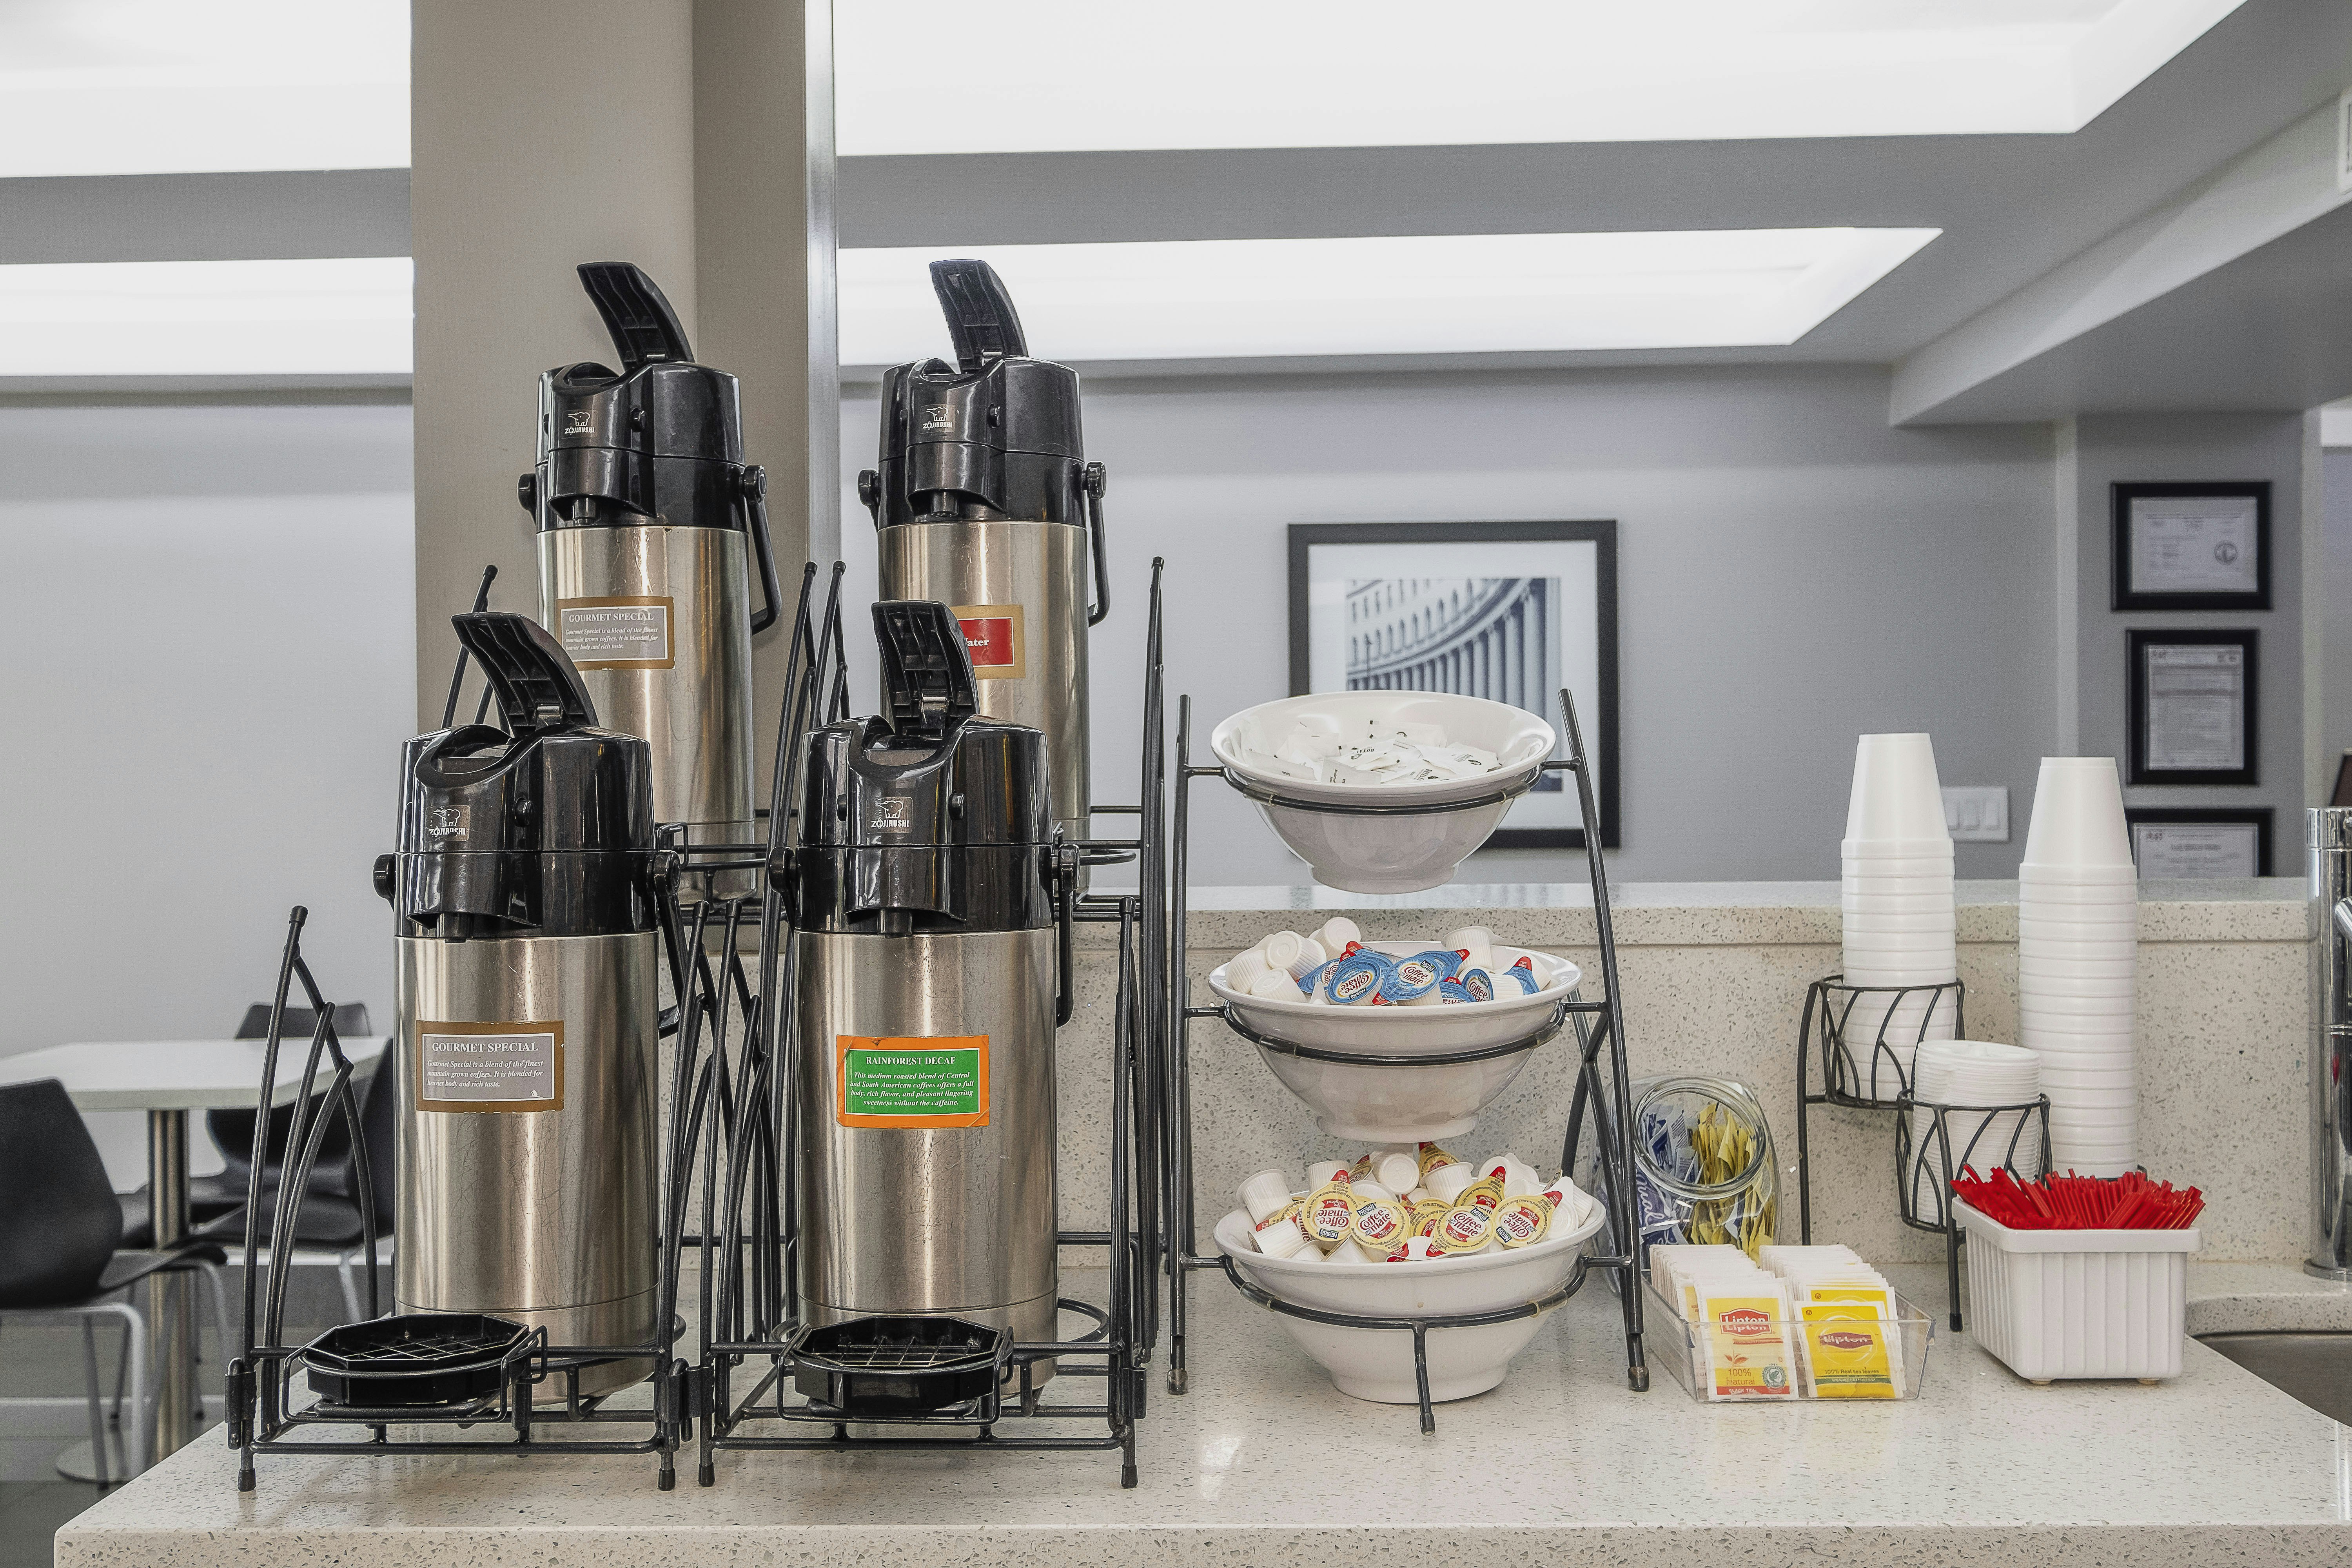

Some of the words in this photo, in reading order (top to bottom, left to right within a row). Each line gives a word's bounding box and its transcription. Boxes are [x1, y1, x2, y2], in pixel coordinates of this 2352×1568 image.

[922, 421, 953, 430] ZOJIRUSHI
[564, 426, 595, 435] ZOJIRUSHI
[569, 613, 612, 622] GOURMET
[613, 612, 654, 621] SPECIAL
[965, 638, 990, 647] ater
[871, 818, 909, 829] ZOJIRUSHI
[1341, 975, 1361, 991] mate
[1404, 974, 1424, 985] mate
[432, 1043, 485, 1053] GOURMET
[487, 1042, 539, 1052] SPECIAL
[504, 1060, 512, 1069] of
[523, 1060, 544, 1069] finest
[866, 1056, 923, 1065] RAINFOREST
[925, 1056, 956, 1065] DECAF
[470, 1070, 492, 1078] coffees.
[532, 1070, 544, 1078] for
[938, 1072, 945, 1081] of
[913, 1081, 935, 1090] coffees
[937, 1081, 956, 1090] offers
[880, 1090, 901, 1098] flavor,
[916, 1090, 943, 1099] pleasant
[945, 1089, 973, 1099] lingering
[931, 1099, 959, 1107] caffeine.
[1370, 1214, 1391, 1232] mate
[1508, 1212, 1530, 1229] mate
[1454, 1221, 1478, 1236] mate
